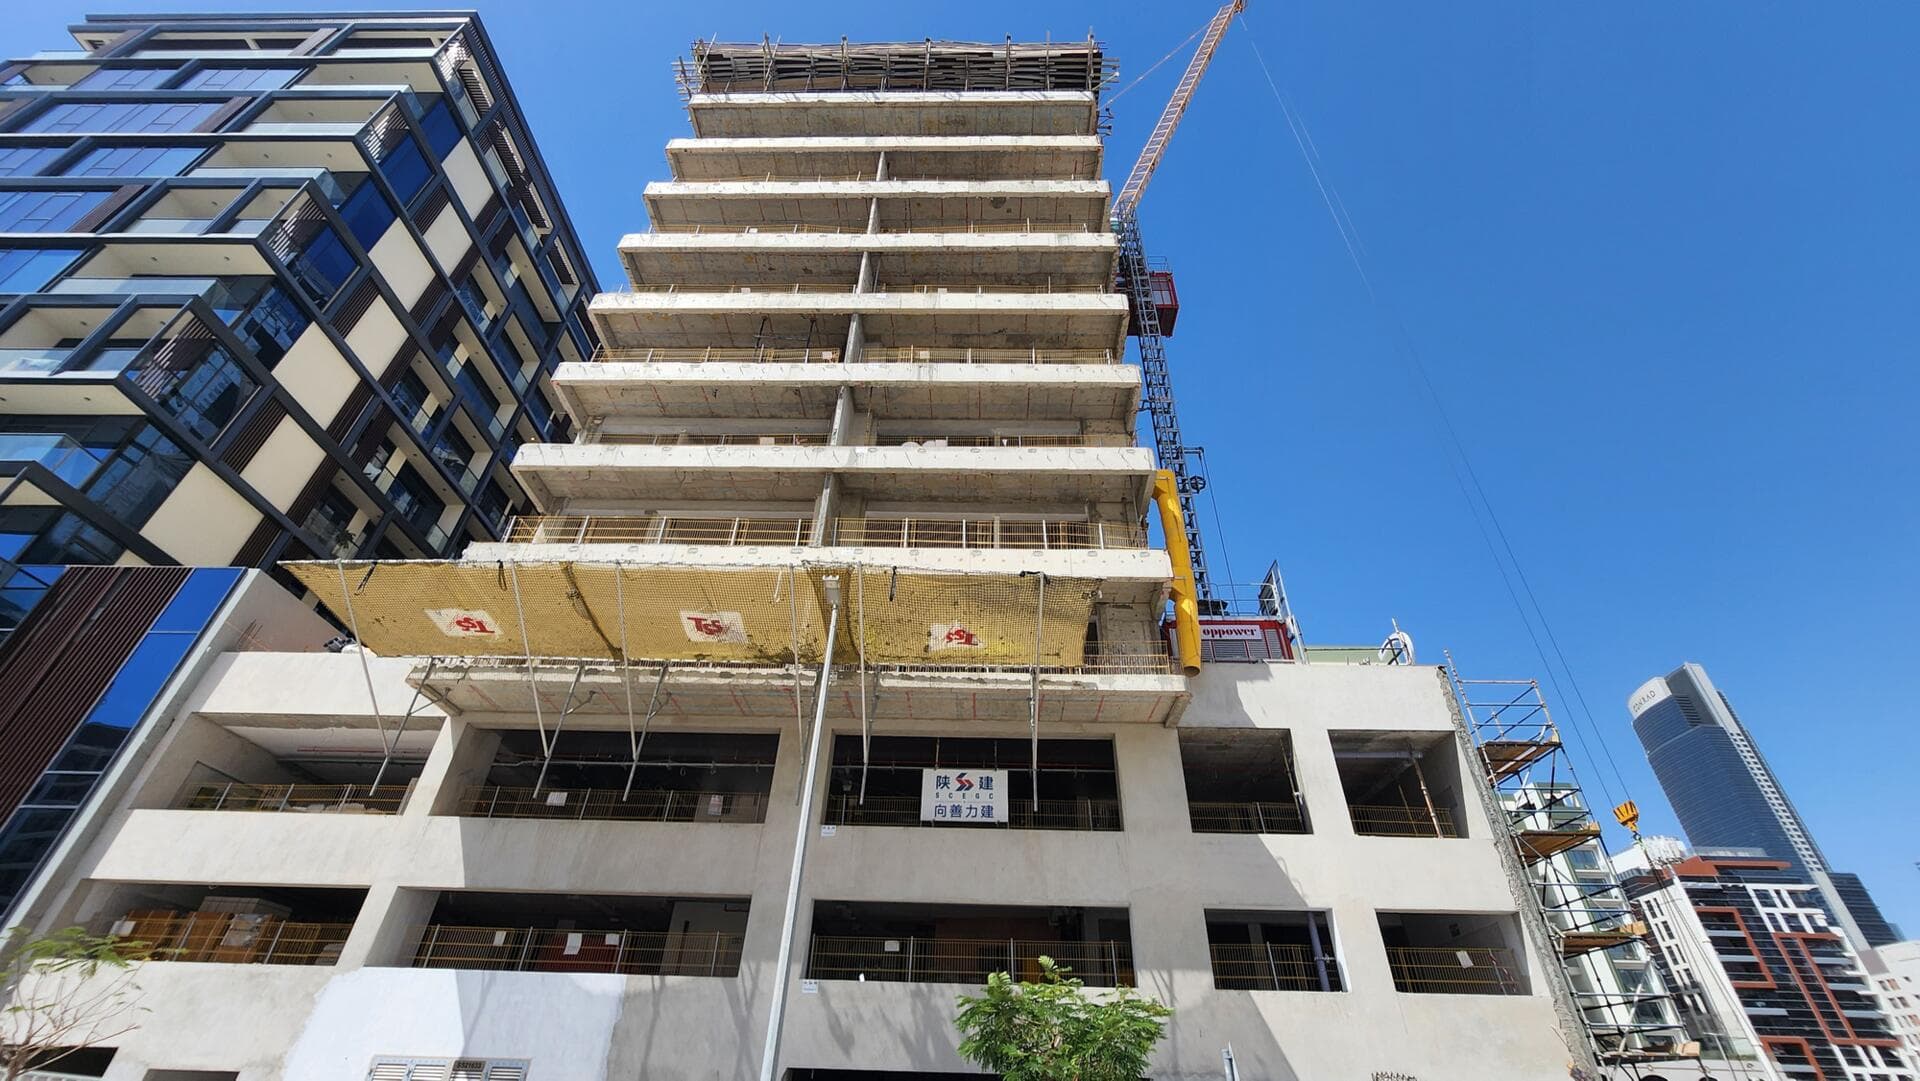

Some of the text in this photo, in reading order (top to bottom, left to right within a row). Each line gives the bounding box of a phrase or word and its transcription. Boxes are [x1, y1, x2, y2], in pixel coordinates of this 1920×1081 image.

[1202, 628, 1257, 638] oppower
[979, 776, 994, 790] 建
[935, 792, 994, 800] SCEGC
[934, 804, 994, 818] 向善力建
